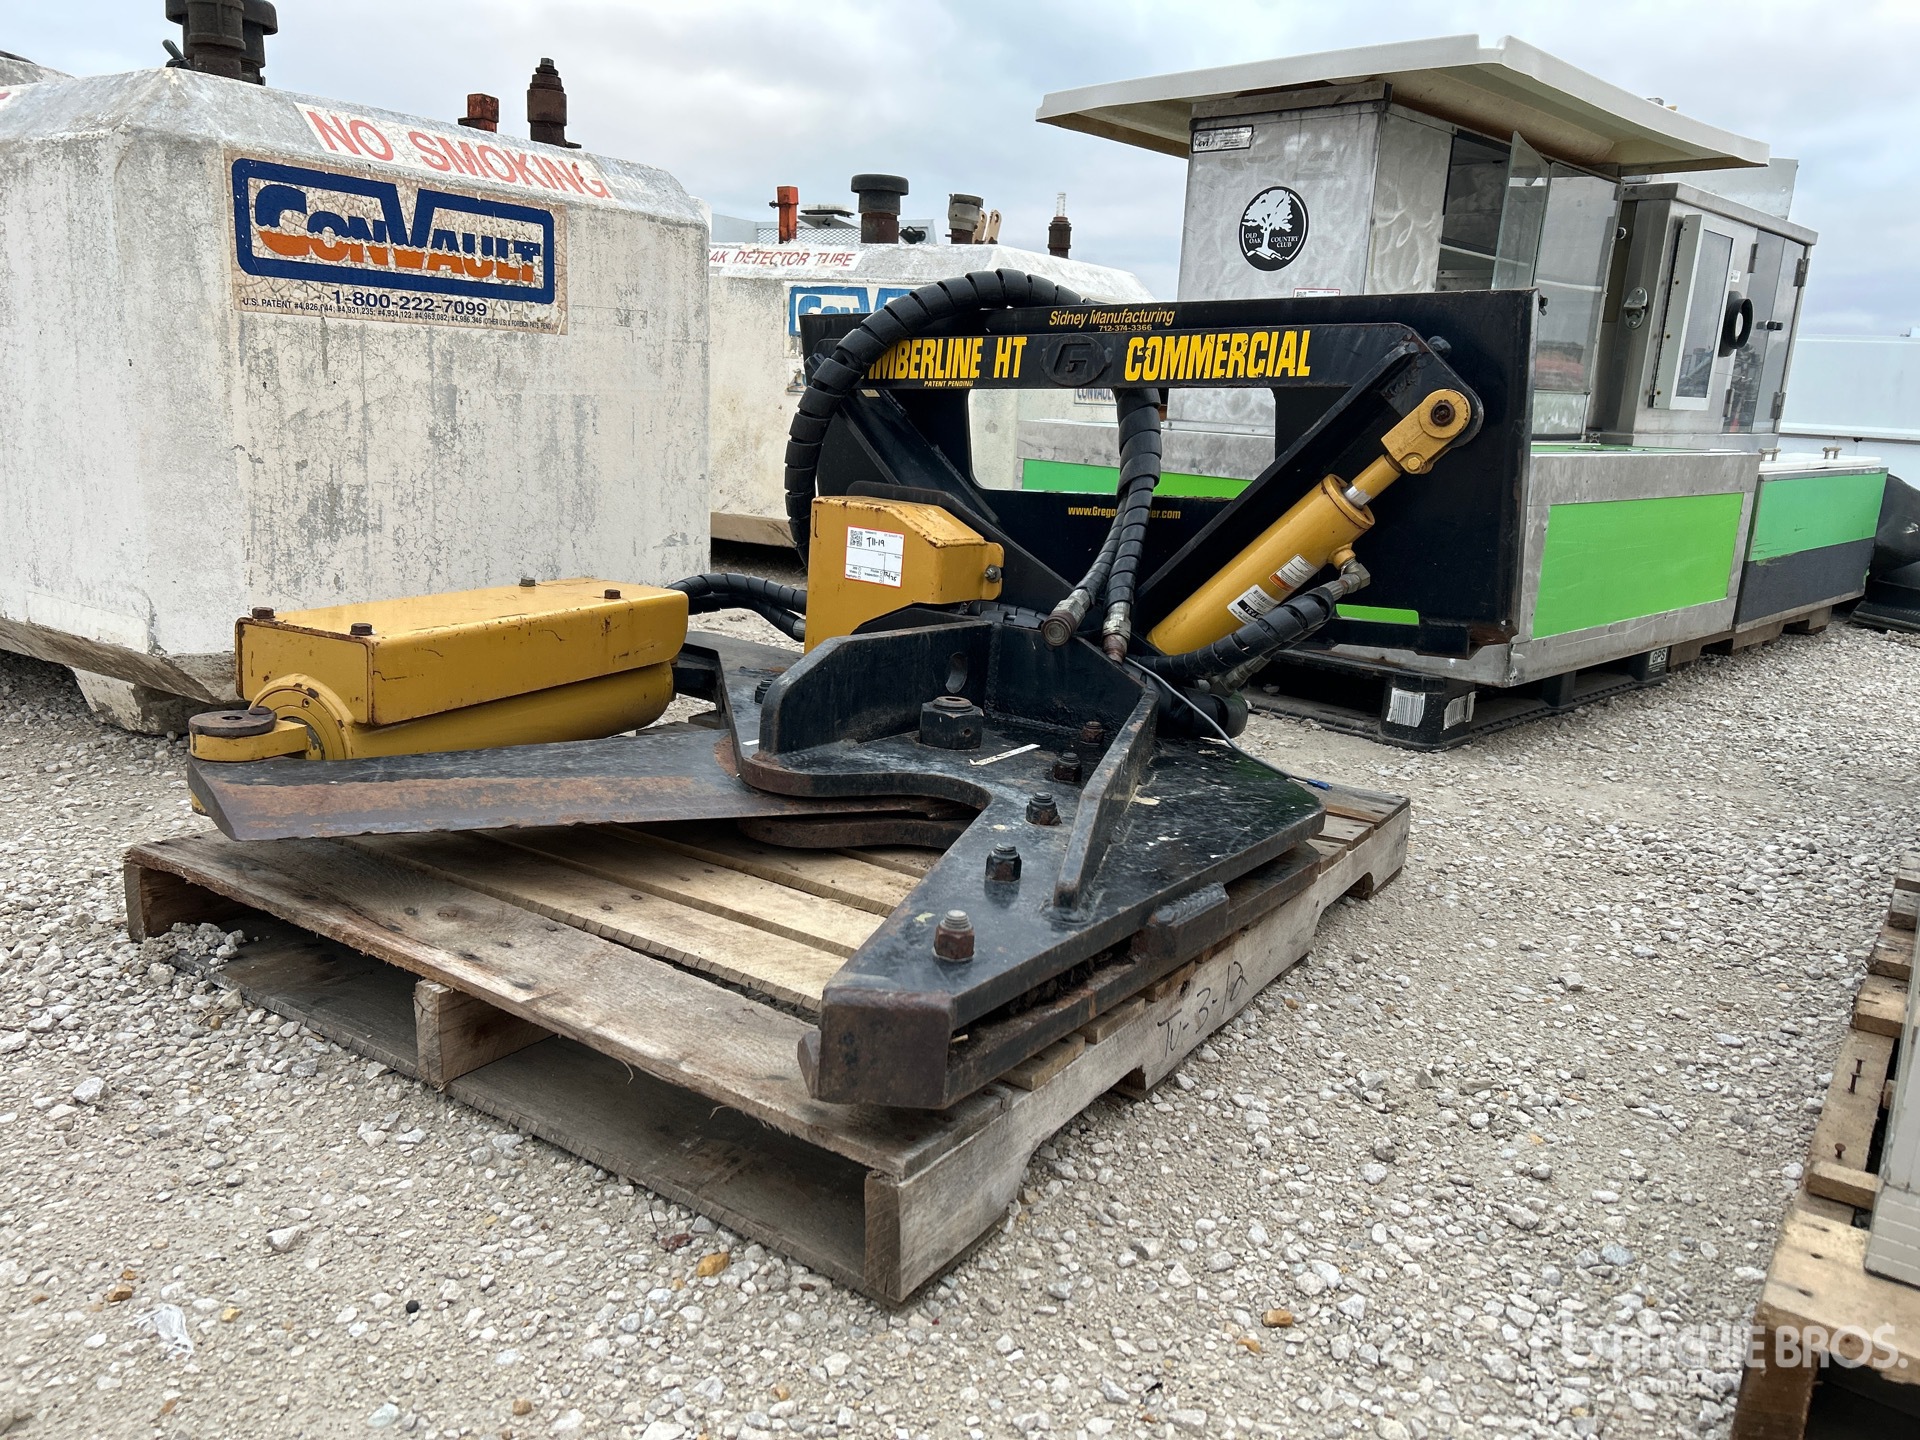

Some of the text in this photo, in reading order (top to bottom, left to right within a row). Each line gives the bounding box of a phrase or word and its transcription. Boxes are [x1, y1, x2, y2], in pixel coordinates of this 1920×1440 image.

[307, 111, 612, 198] NO SMOKING
[1270, 235, 1298, 243] COUNTRY
[733, 250, 810, 266] DETECTOR
[262, 299, 291, 309] PATENT
[332, 290, 487, 316] 1-800-222-7099
[1049, 307, 1175, 328] Sidney Manufacturing
[1099, 324, 1152, 332] 712-374-3366
[861, 336, 1027, 380] MBERLINE HT
[1125, 330, 1311, 381] COMMERCIAL
